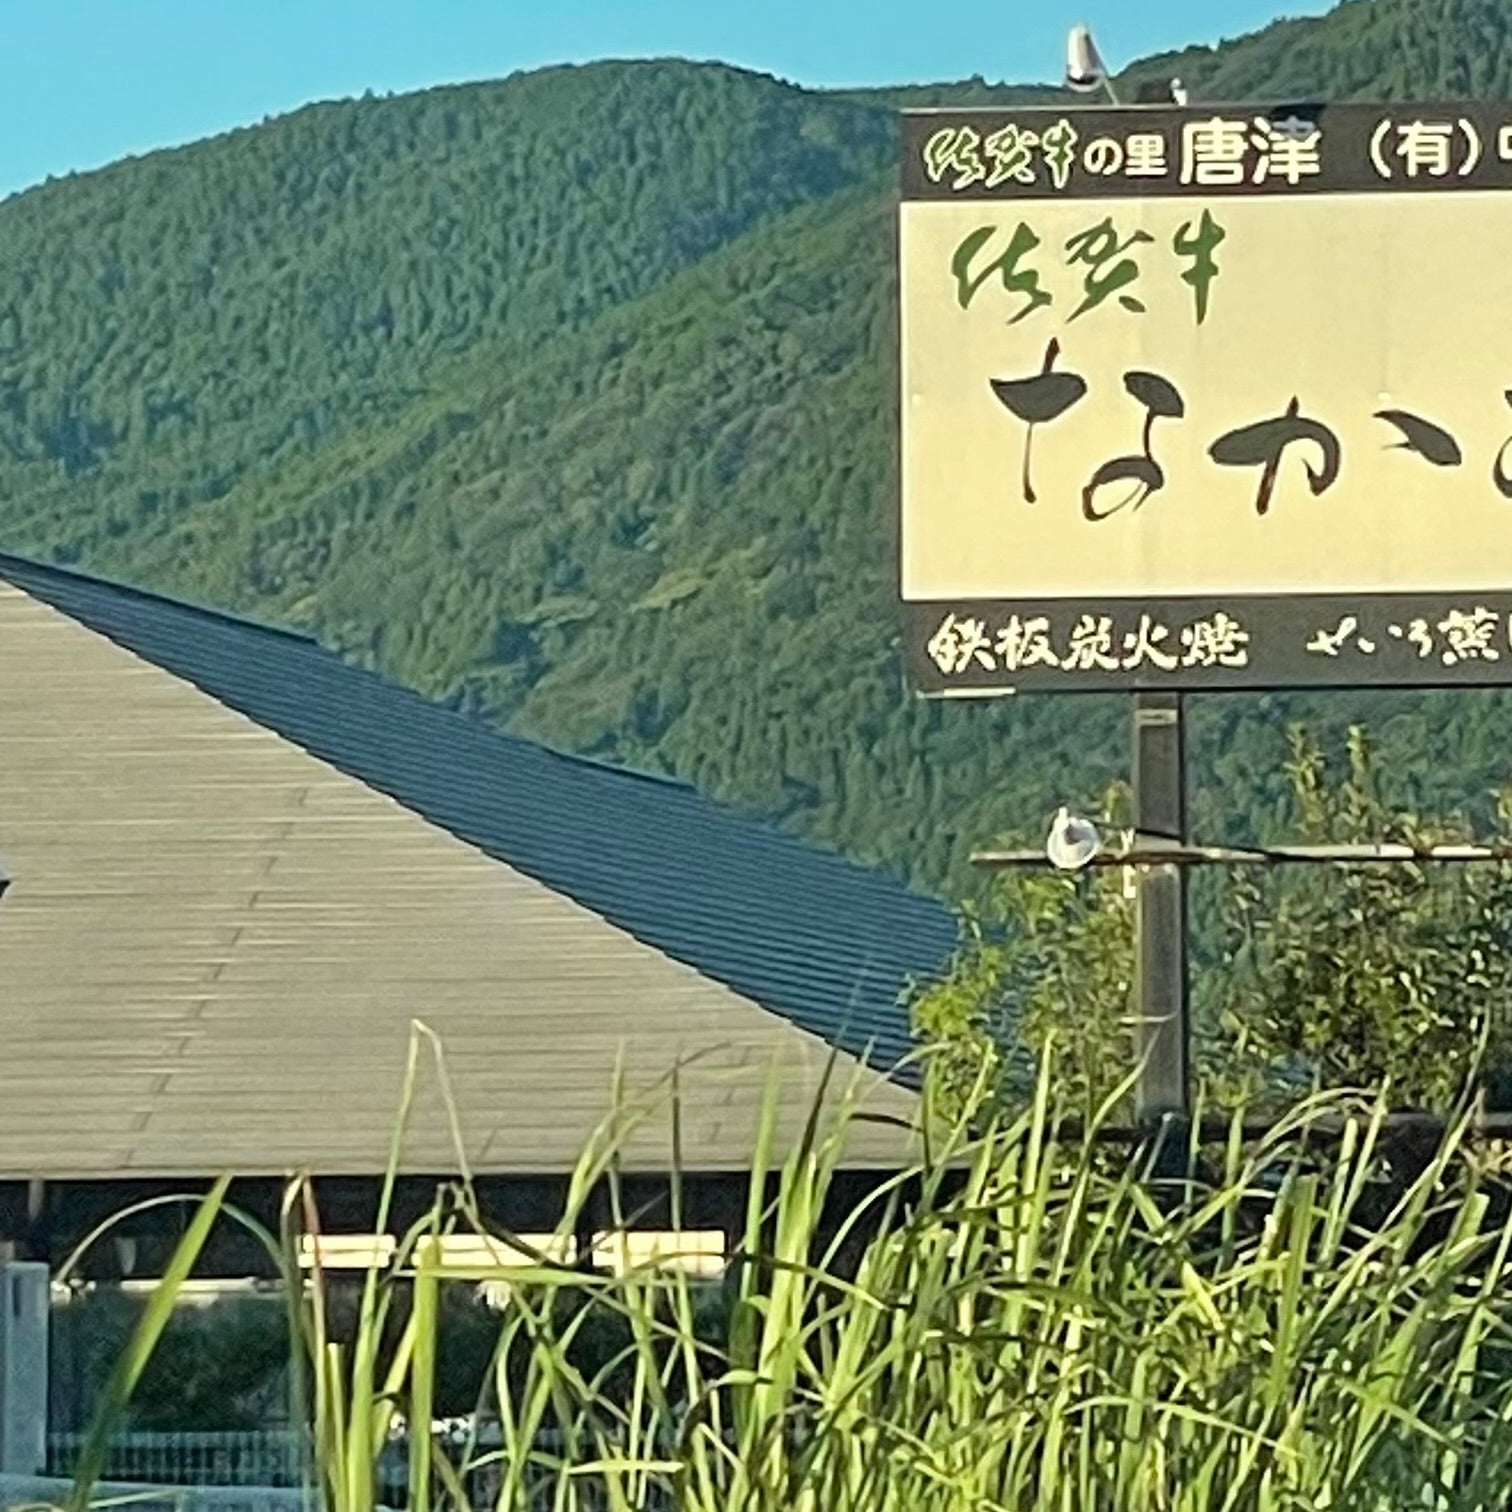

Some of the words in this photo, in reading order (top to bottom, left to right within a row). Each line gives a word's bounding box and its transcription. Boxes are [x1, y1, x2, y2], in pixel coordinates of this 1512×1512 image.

[951, 208, 1227, 326] 佐賀牛
[927, 612, 1249, 675] 鉄板炭火焼
